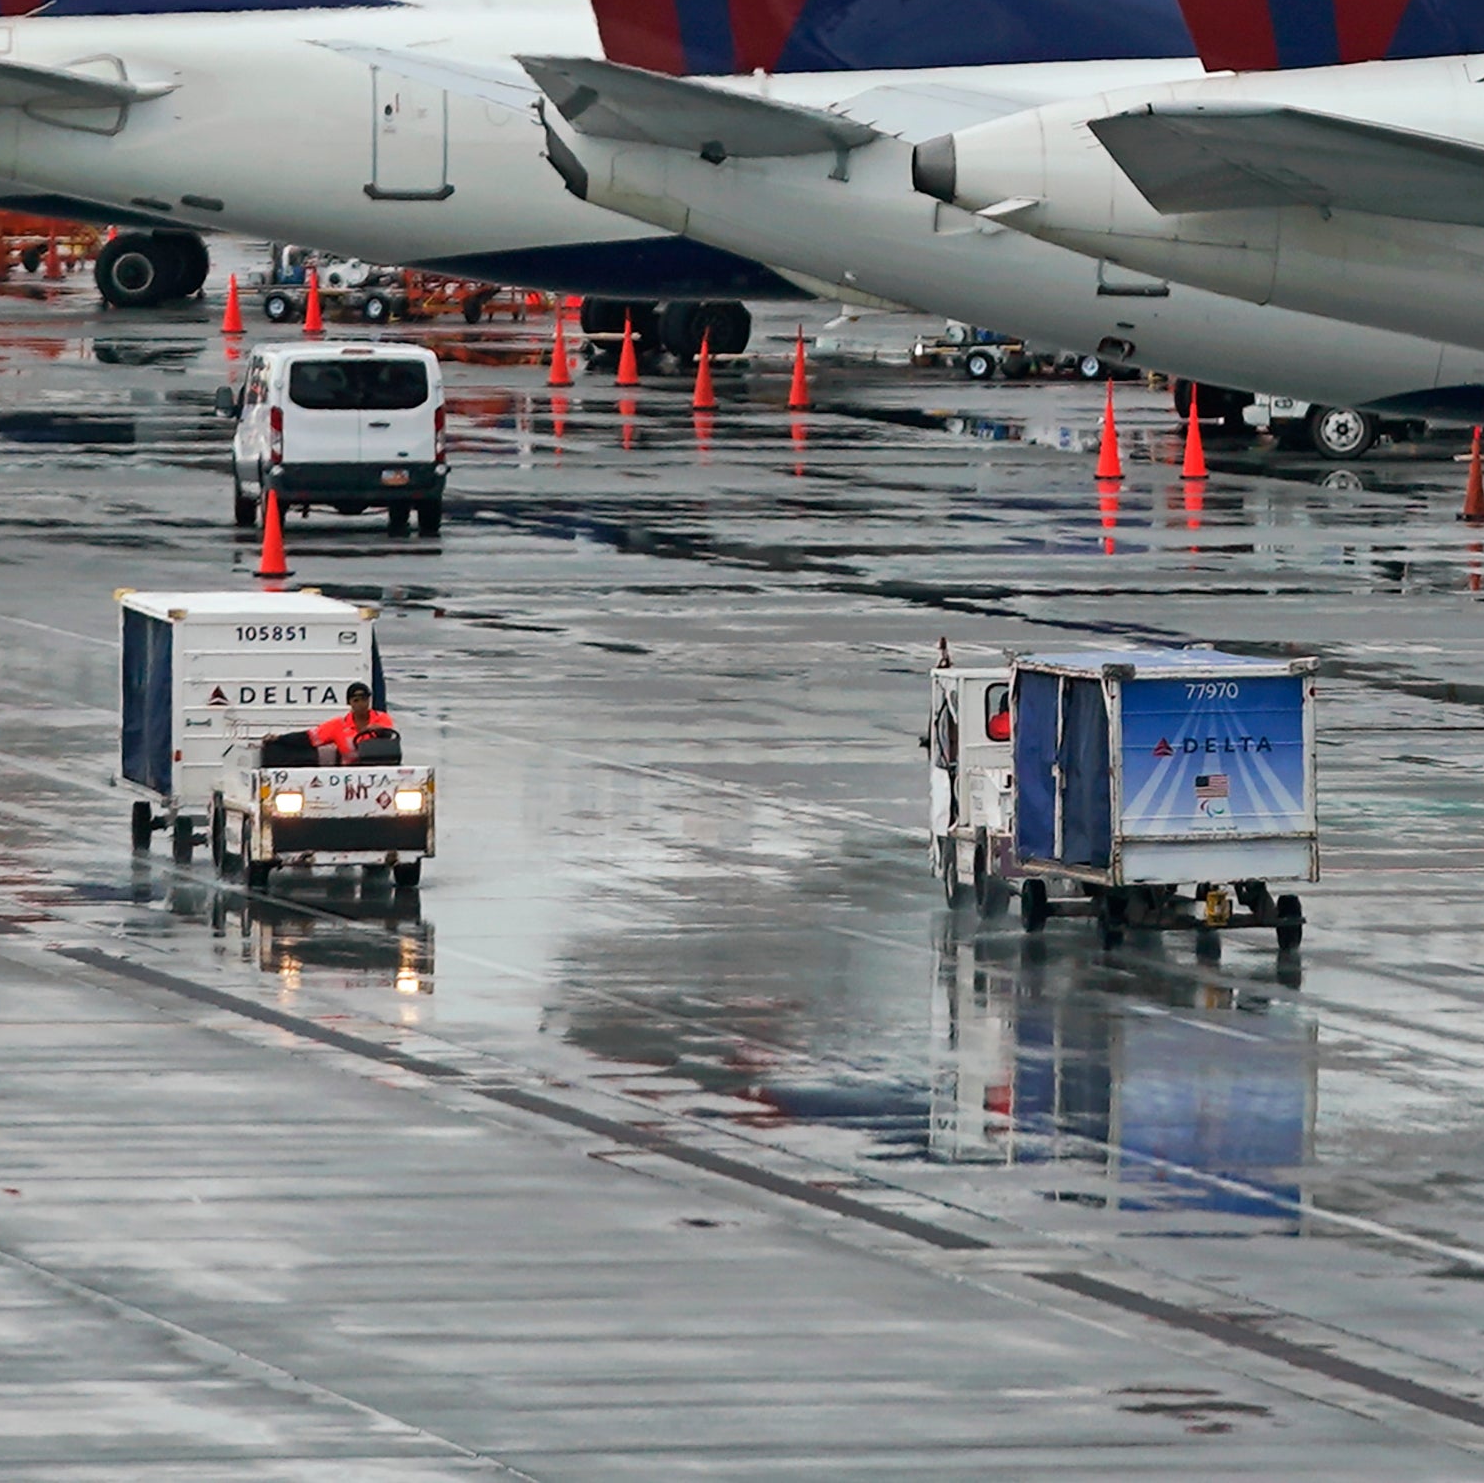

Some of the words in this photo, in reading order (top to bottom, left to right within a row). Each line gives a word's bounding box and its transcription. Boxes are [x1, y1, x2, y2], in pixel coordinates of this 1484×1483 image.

[236, 625, 308, 641] 105851
[239, 686, 339, 705] DELTA
[1185, 682, 1240, 700] 77970
[1182, 736, 1273, 754] DELTA
